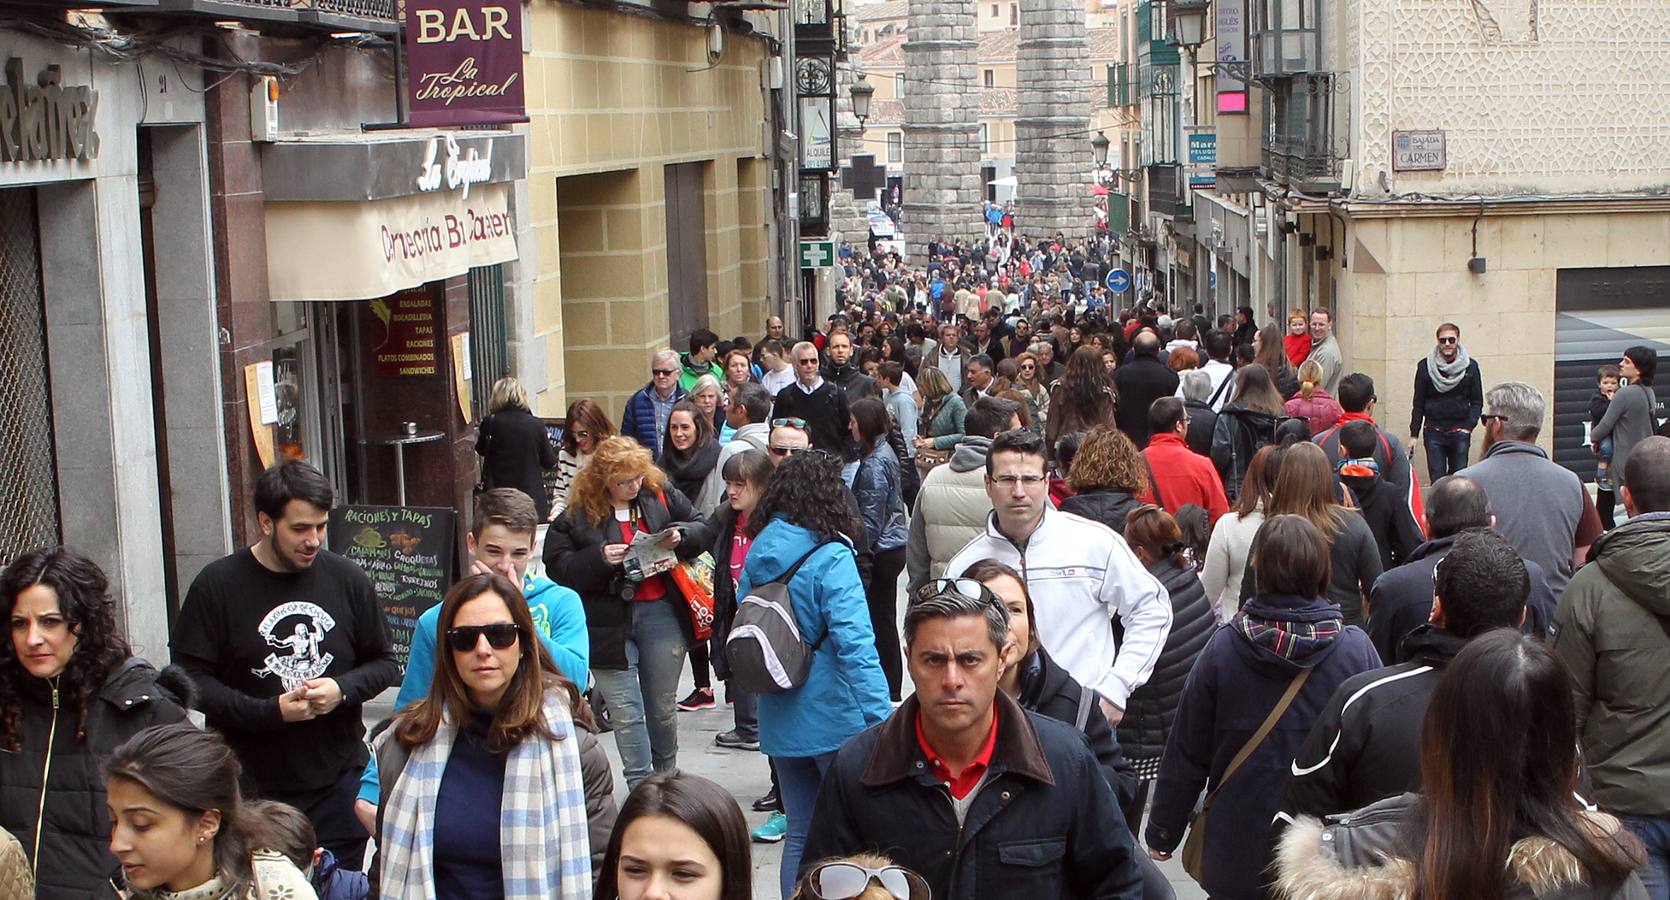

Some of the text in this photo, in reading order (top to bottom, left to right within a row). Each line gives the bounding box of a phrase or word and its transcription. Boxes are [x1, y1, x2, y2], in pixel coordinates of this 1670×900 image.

[416, 6, 512, 43] BAR
[440, 57, 478, 84] La
[416, 72, 518, 106] Tropical
[1412, 136, 1440, 144] BAJADA
[1400, 152, 1439, 164] CARMEN
[406, 340, 434, 348] RACIONES
[398, 352, 435, 362] COMBINADOS
[400, 366, 436, 376] SANDWICHES
[345, 508, 433, 529] RACIONES Y TAPAS
[394, 550, 438, 567] CROQUETAS
